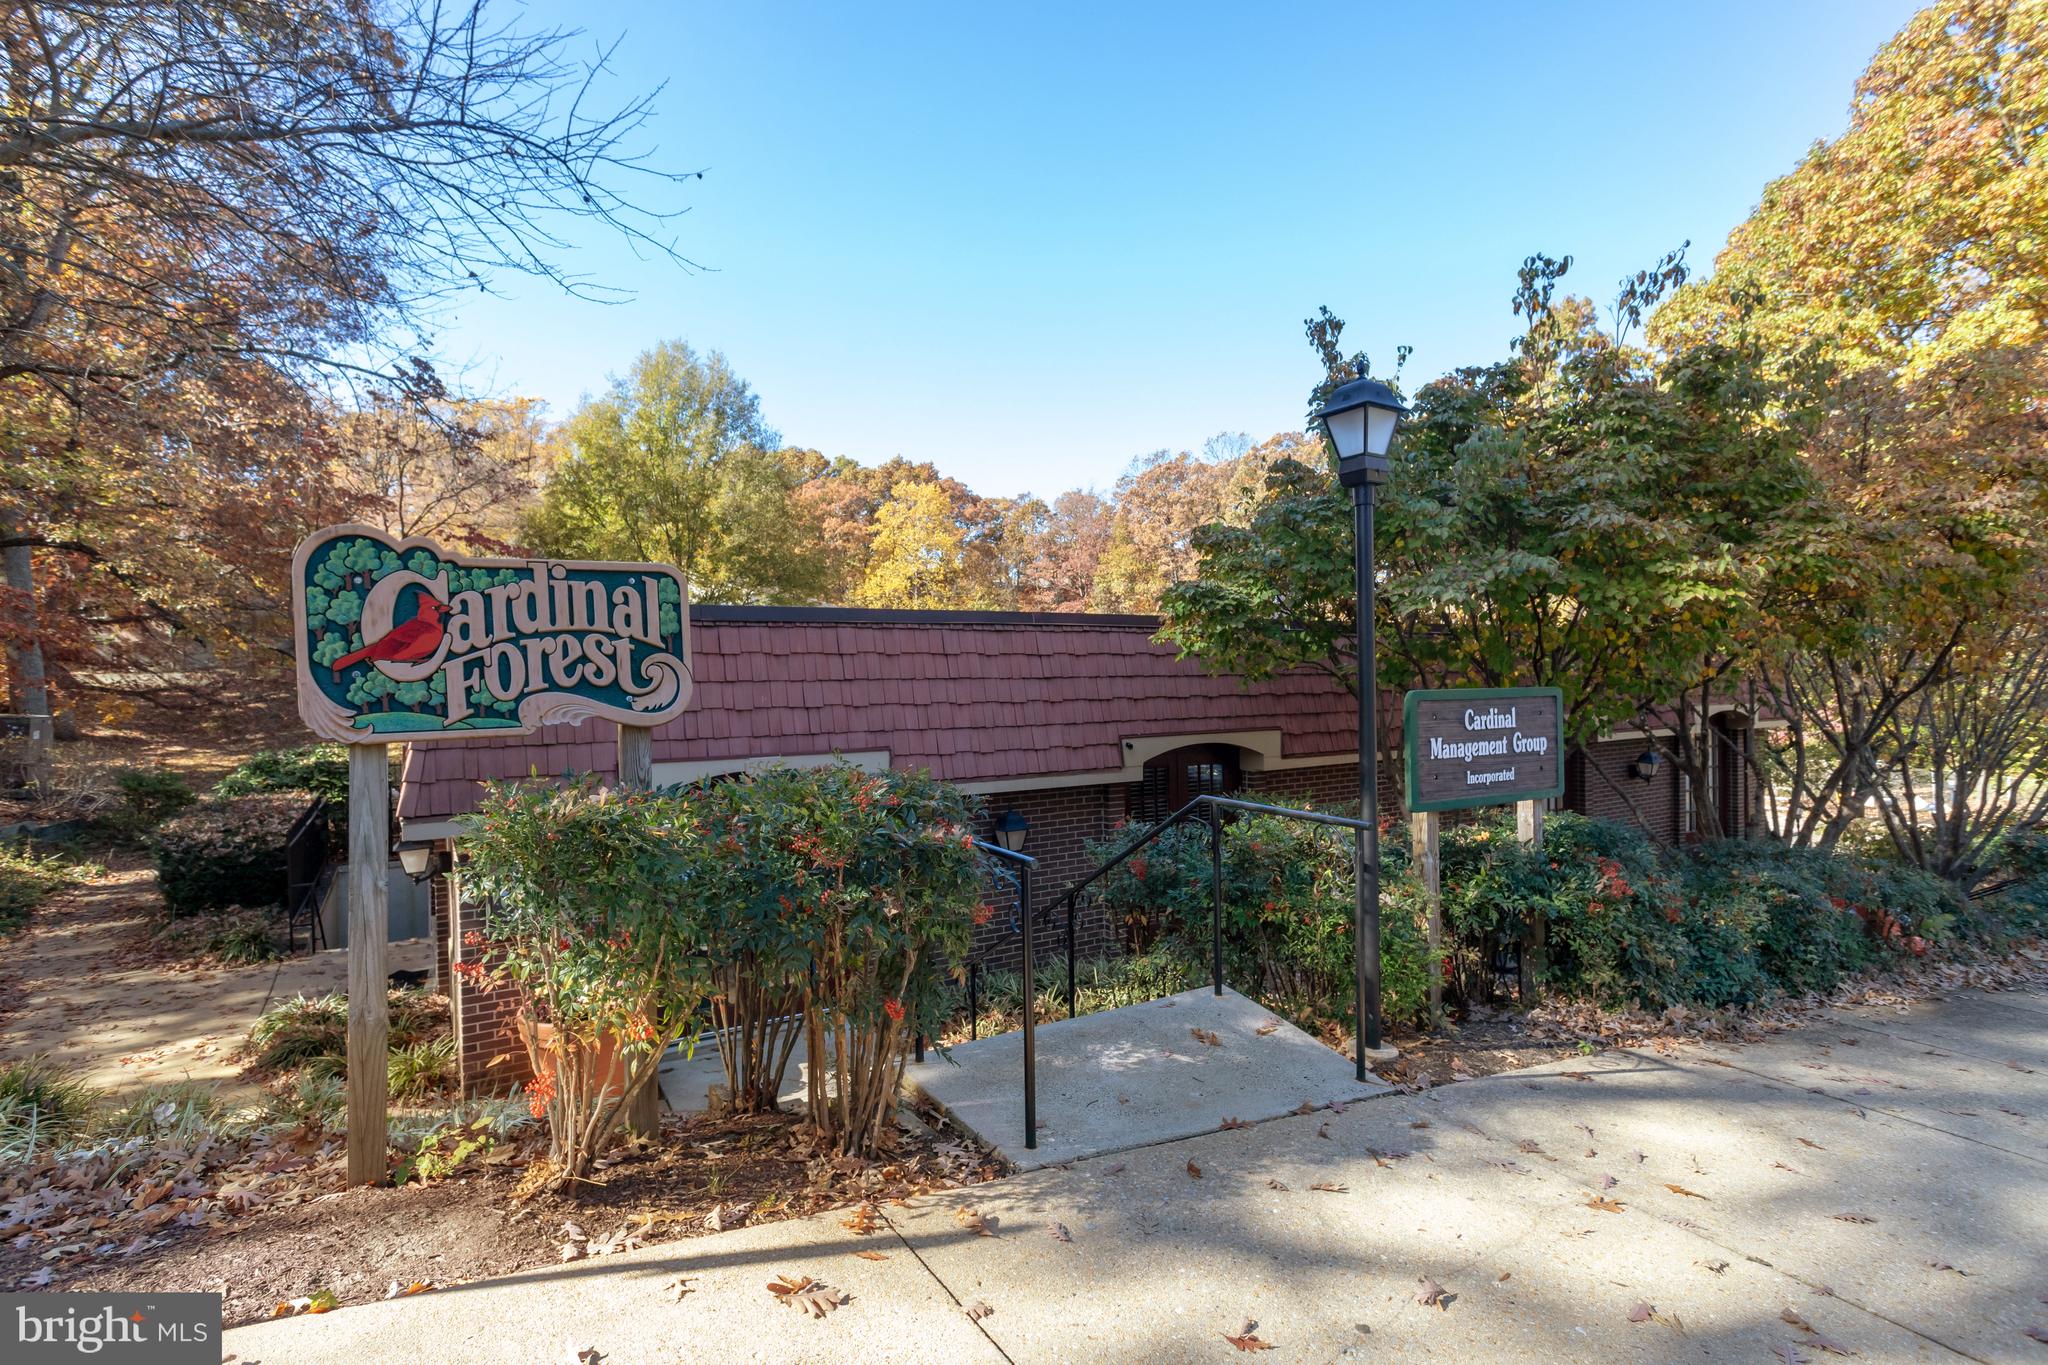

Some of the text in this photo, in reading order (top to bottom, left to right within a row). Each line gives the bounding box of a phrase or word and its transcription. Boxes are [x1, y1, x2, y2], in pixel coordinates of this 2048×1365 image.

[361, 561, 666, 682] Cardinal
[440, 633, 665, 728] Forest
[1464, 706, 1517, 731] Cardinal
[1430, 731, 1548, 762] Management Group
[1466, 767, 1515, 786] Incorporated
